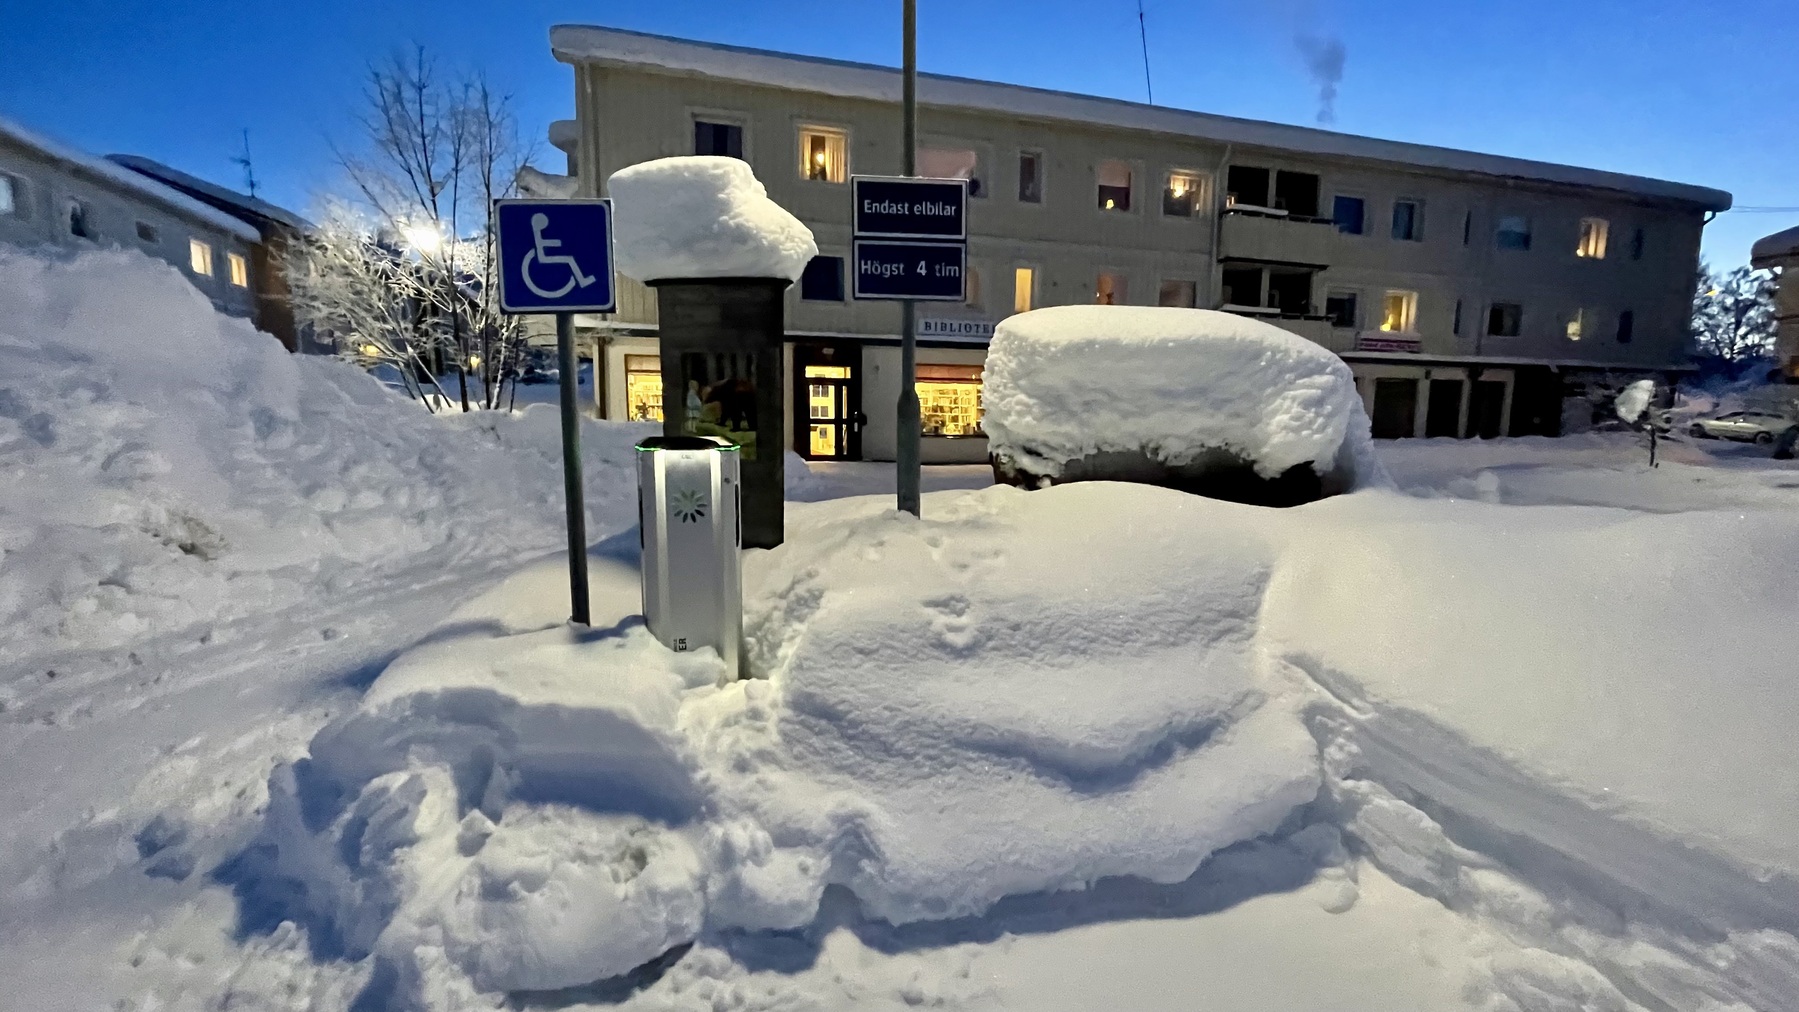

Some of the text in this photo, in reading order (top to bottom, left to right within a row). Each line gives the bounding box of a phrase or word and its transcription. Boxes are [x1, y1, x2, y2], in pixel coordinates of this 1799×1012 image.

[864, 199, 957, 216] Endast elbilar
[861, 259, 960, 278] Högst 4 tim
